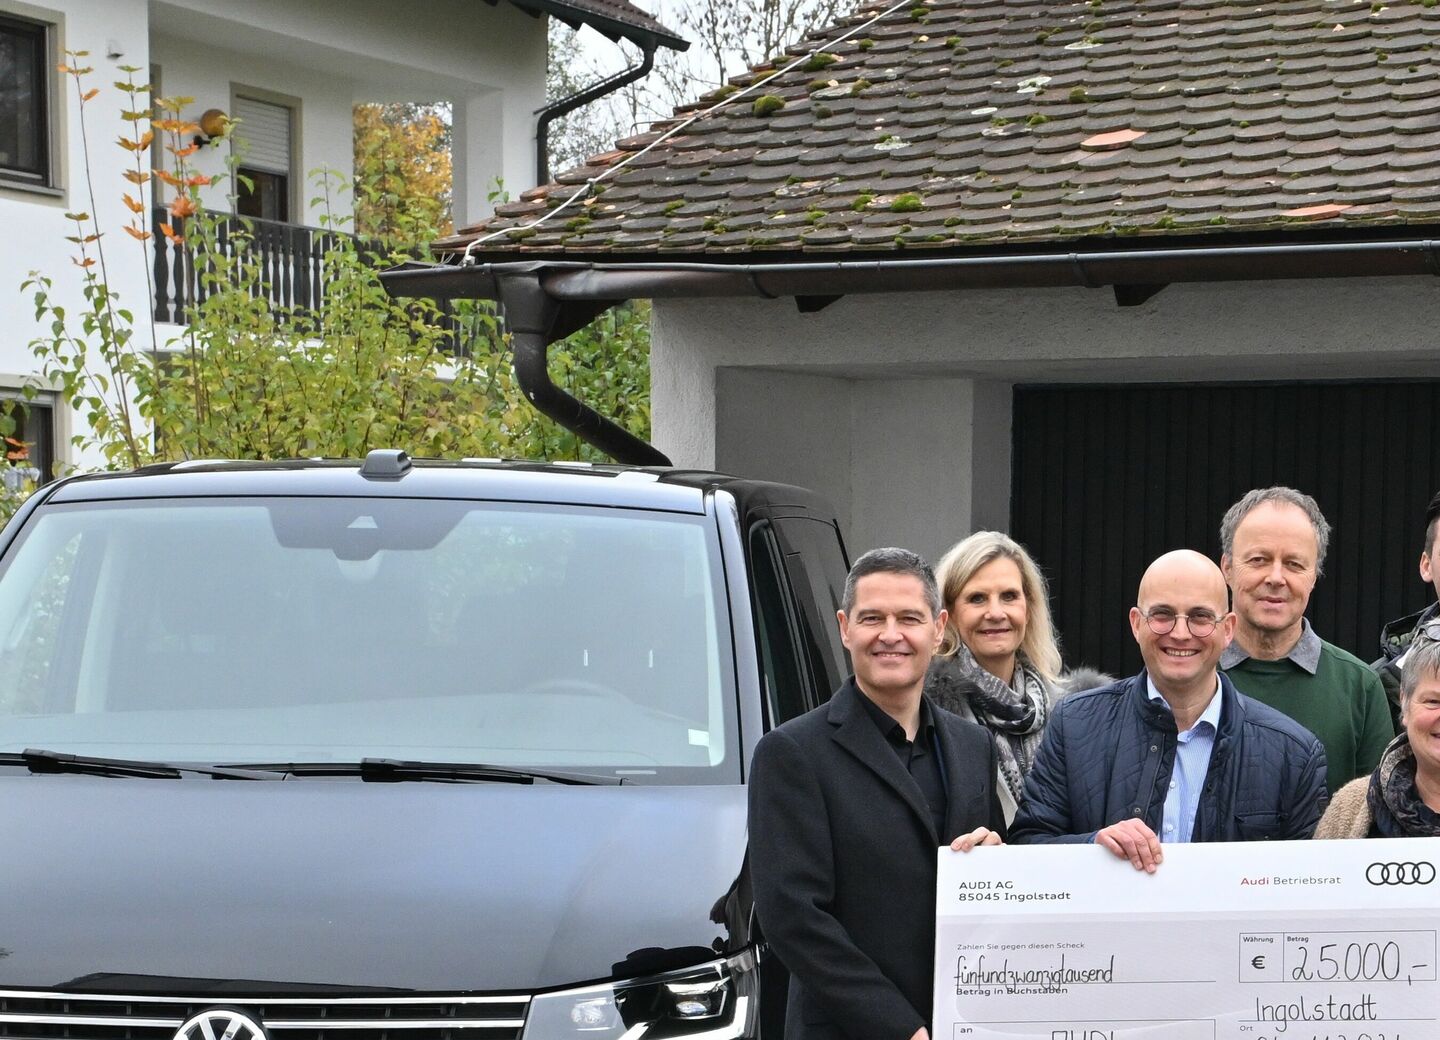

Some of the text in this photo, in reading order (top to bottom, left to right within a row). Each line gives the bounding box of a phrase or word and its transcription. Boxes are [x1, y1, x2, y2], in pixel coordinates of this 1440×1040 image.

[958, 880, 1014, 890] AUDI AG
[1240, 875, 1342, 886] Audi Betriebsrat
[958, 891, 1072, 902] 85045 Ingolstadt
[1243, 935, 1274, 944] Währung
[1286, 935, 1309, 943] Betrag
[957, 943, 985, 951] Zahlen
[1001, 944, 1027, 952] gegen
[1028, 942, 1055, 950] diesen
[1251, 955, 1266, 970] €
[954, 954, 1115, 992] fünfundzwanzigtausend
[956, 986, 1069, 997] Betrag in Buchstaben
[1256, 994, 1377, 1032] Ingolstadt
